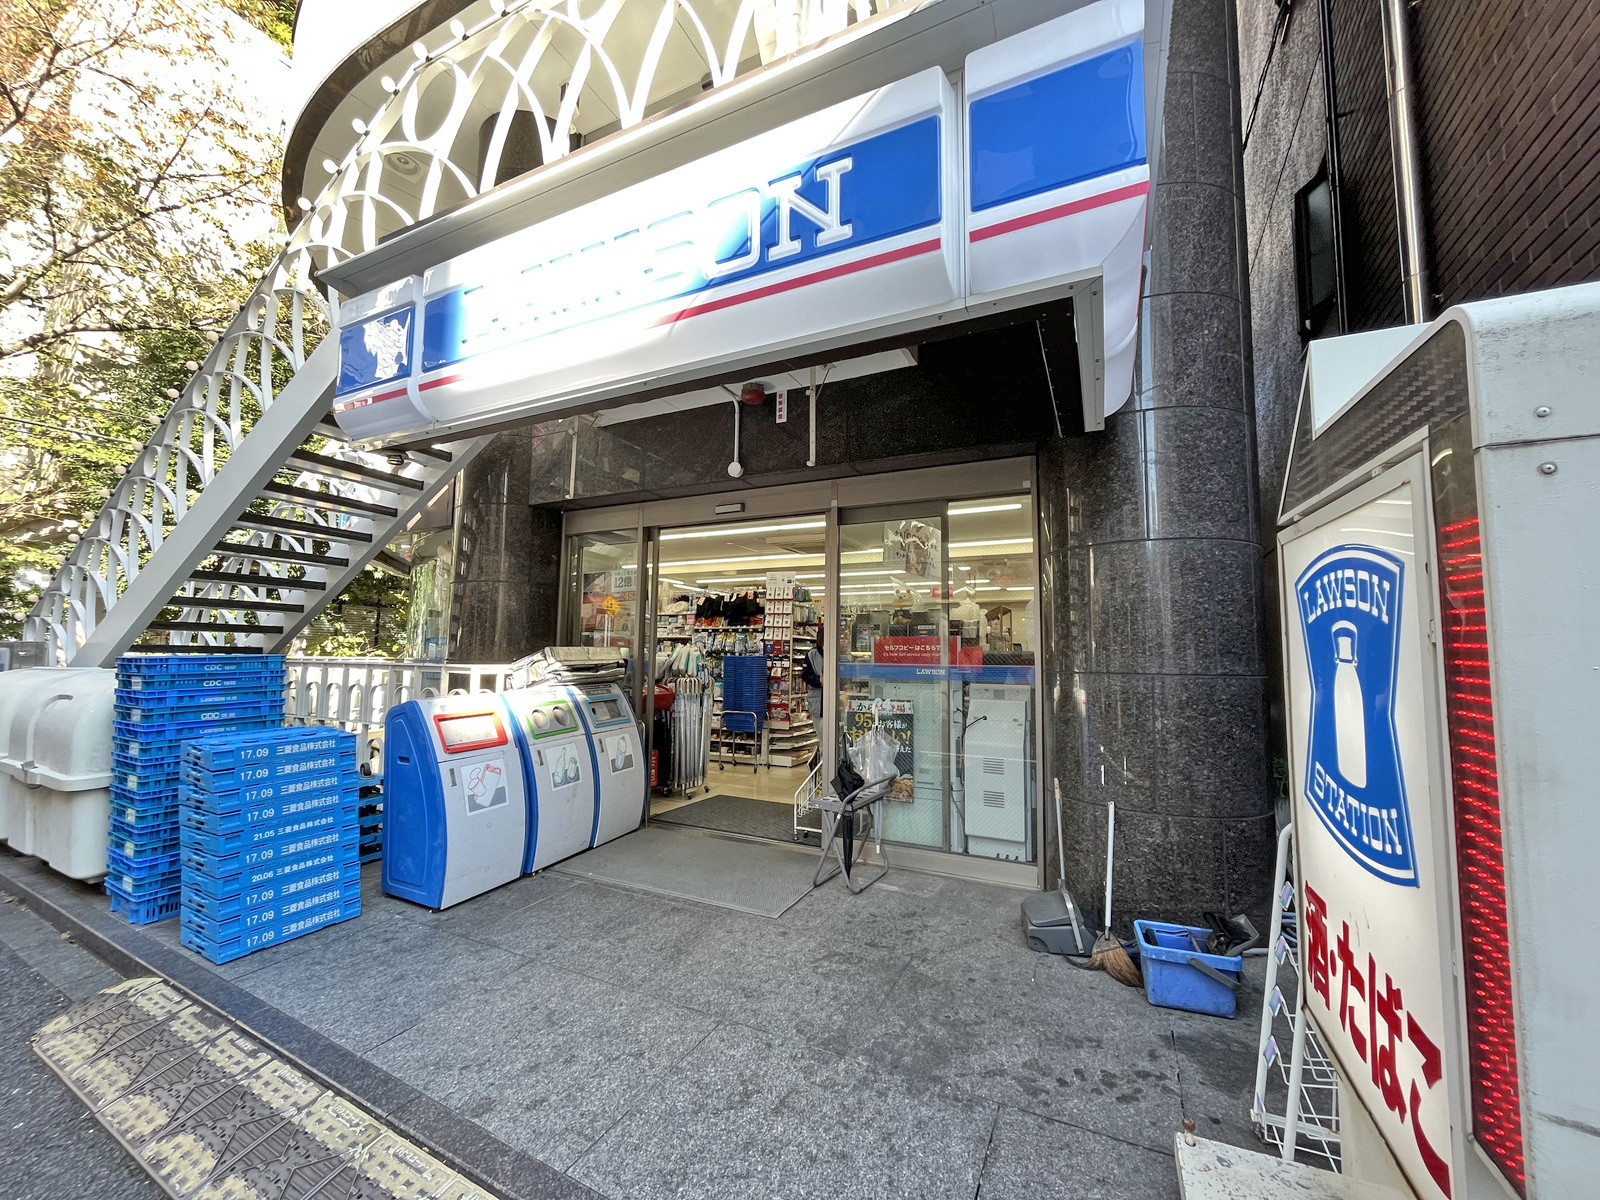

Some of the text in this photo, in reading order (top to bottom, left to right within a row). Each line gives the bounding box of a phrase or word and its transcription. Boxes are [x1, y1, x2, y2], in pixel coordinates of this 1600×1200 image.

[462, 156, 853, 345] SON
[1303, 569, 1390, 625] LAWSON
[201, 712, 219, 720] CDC
[240, 739, 336, 760] 17.09 三菱食品株式会社
[240, 758, 336, 781] 17.09 三菱食品株式会社
[245, 776, 338, 801] 17.09 三菱食品株式会社
[247, 795, 339, 822] 17.09 三菱食品株式会社
[1313, 761, 1402, 856] STATION
[253, 816, 334, 841] 21.05 三菱食品株式会社
[245, 833, 339, 864] 17.09 三菱食品株式会社
[251, 854, 334, 883] 20.06 三菱食品株式会社
[246, 870, 340, 905] 17.09 三菱食品株式会社
[246, 890, 340, 926] 17.09 三菱食品株式会社
[246, 909, 340, 947] 17.09 三菱食品株式会社
[1305, 880, 1452, 1199] 酒・たばこ
